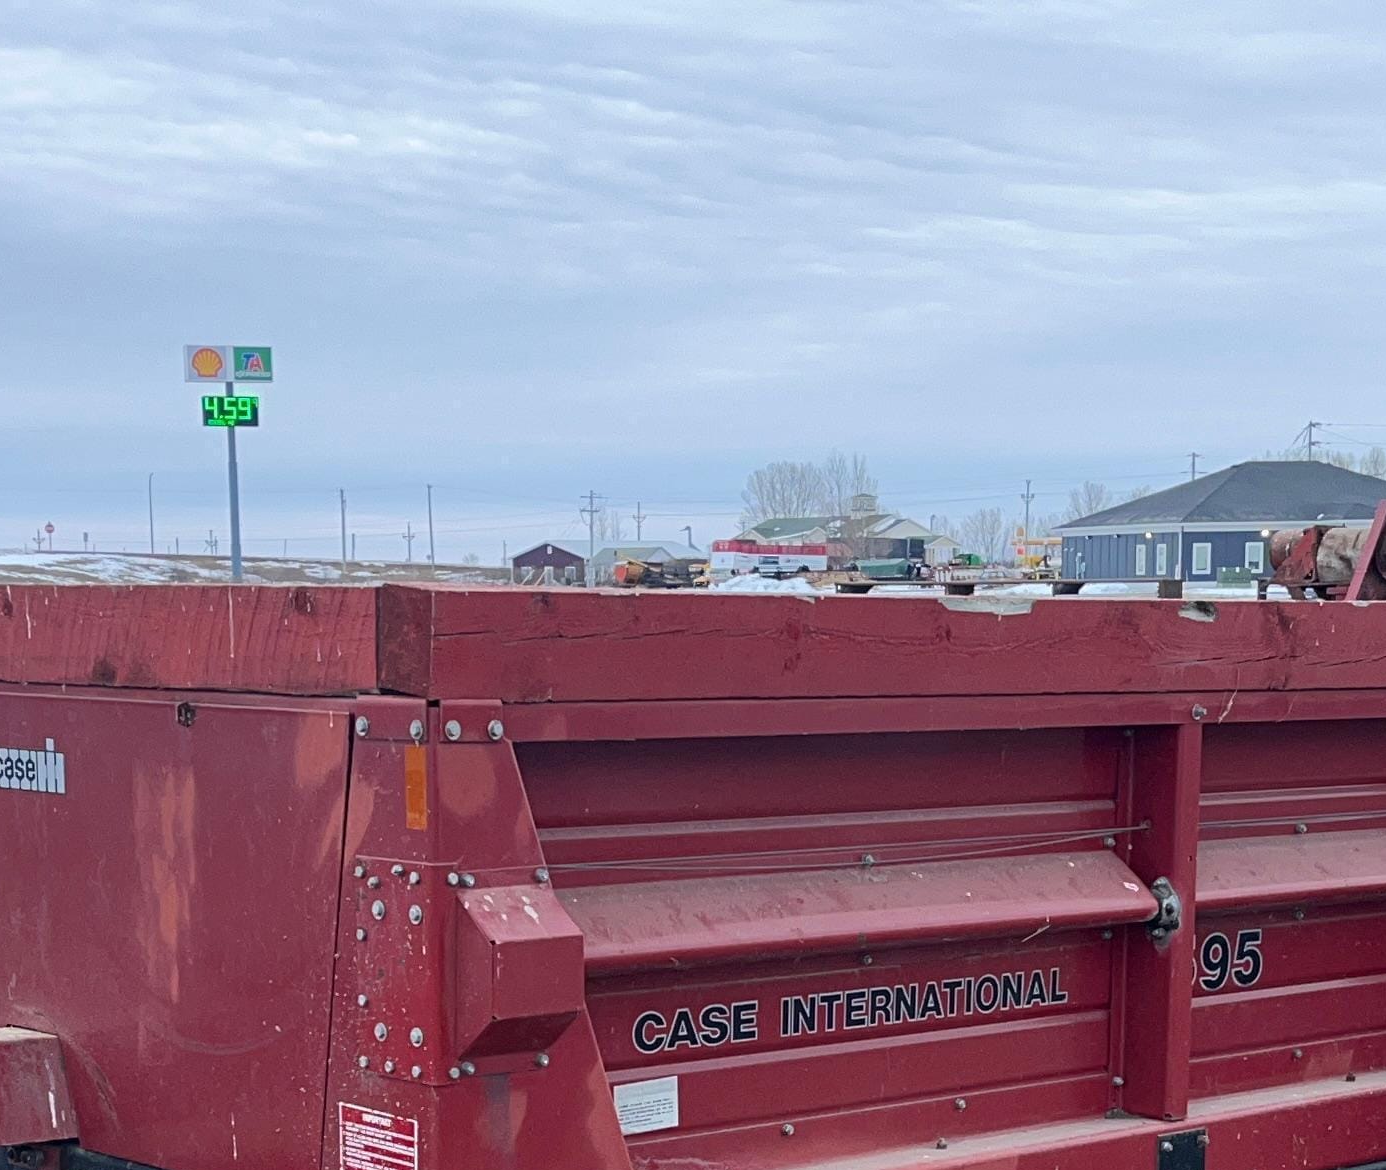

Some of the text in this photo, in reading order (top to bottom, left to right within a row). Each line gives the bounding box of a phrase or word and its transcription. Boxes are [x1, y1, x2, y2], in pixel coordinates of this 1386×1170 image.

[1192, 928, 1262, 991] 95
[632, 968, 1068, 1054] CASE INTERNATIONAL
